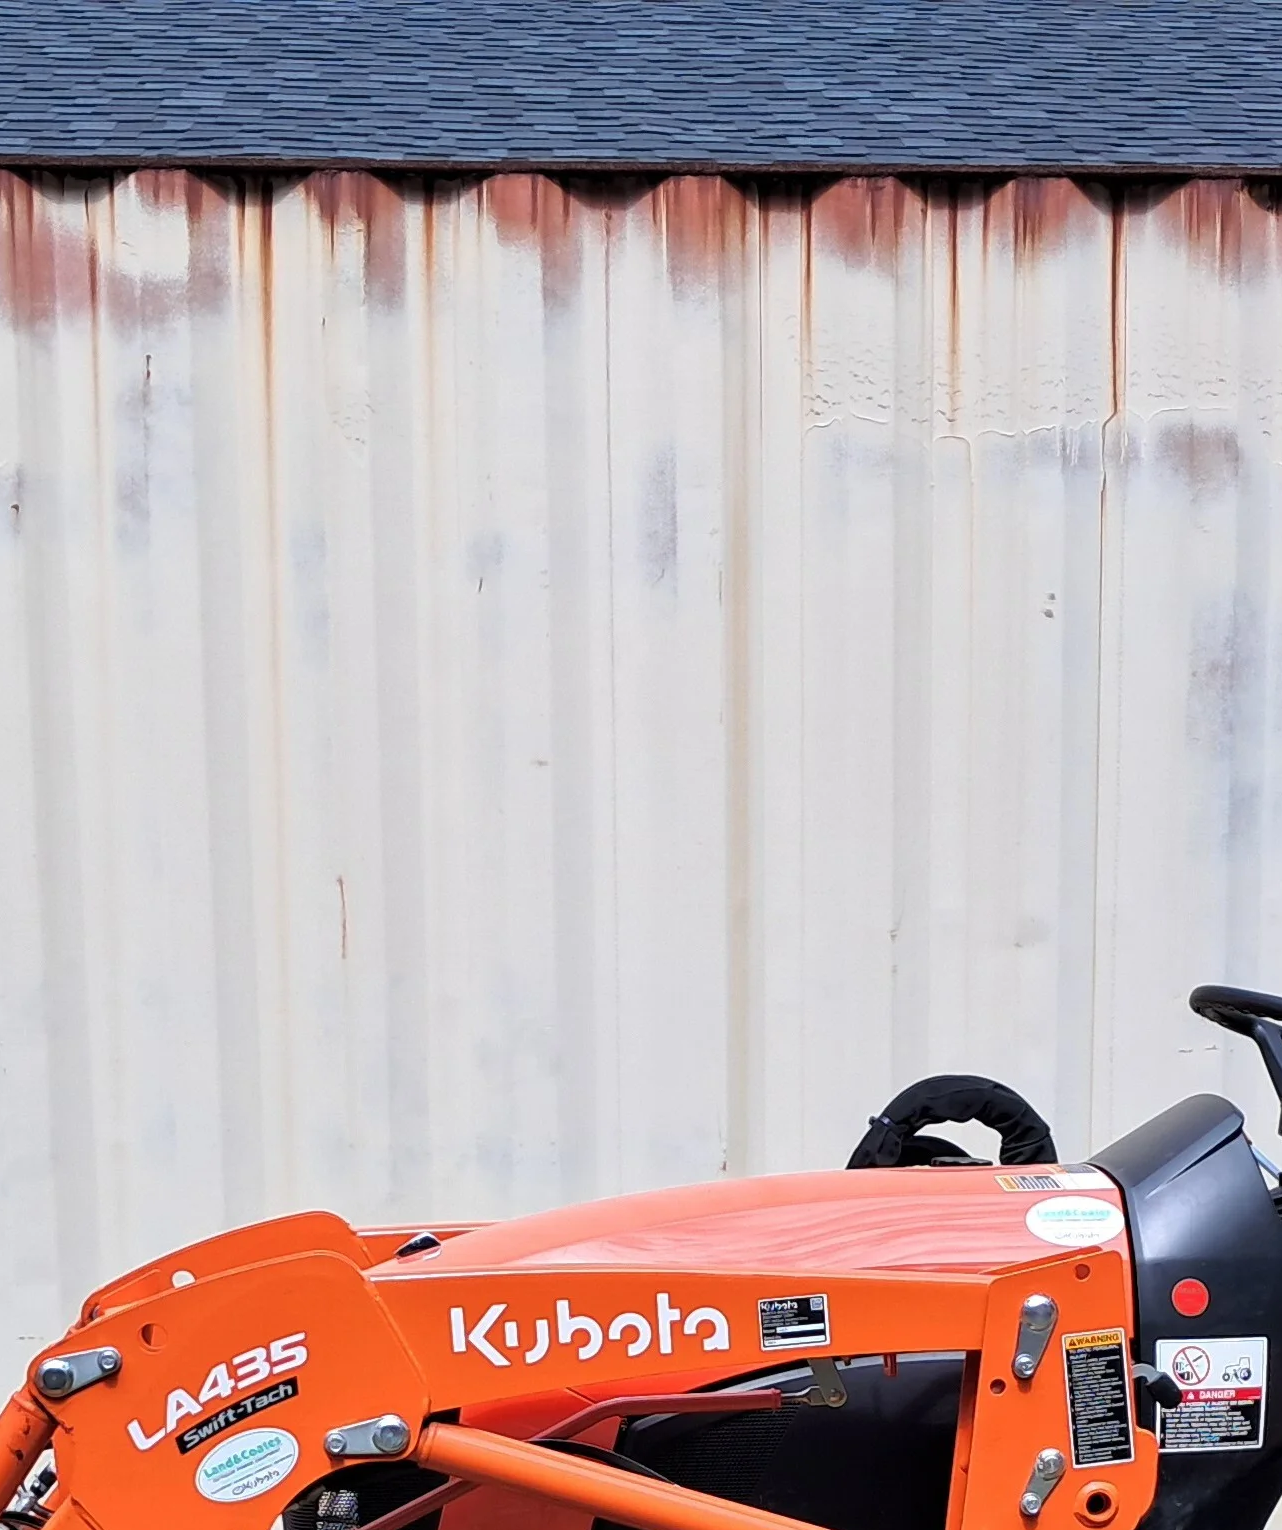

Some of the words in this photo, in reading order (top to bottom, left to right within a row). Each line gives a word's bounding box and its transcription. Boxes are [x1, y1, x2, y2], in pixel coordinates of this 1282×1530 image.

[450, 1292, 730, 1367] Kubota
[760, 1301, 798, 1311] Kubota
[127, 1331, 308, 1450] LA435
[183, 1383, 293, 1450] Swift-Tach
[1199, 1389, 1236, 1400] DANGER
